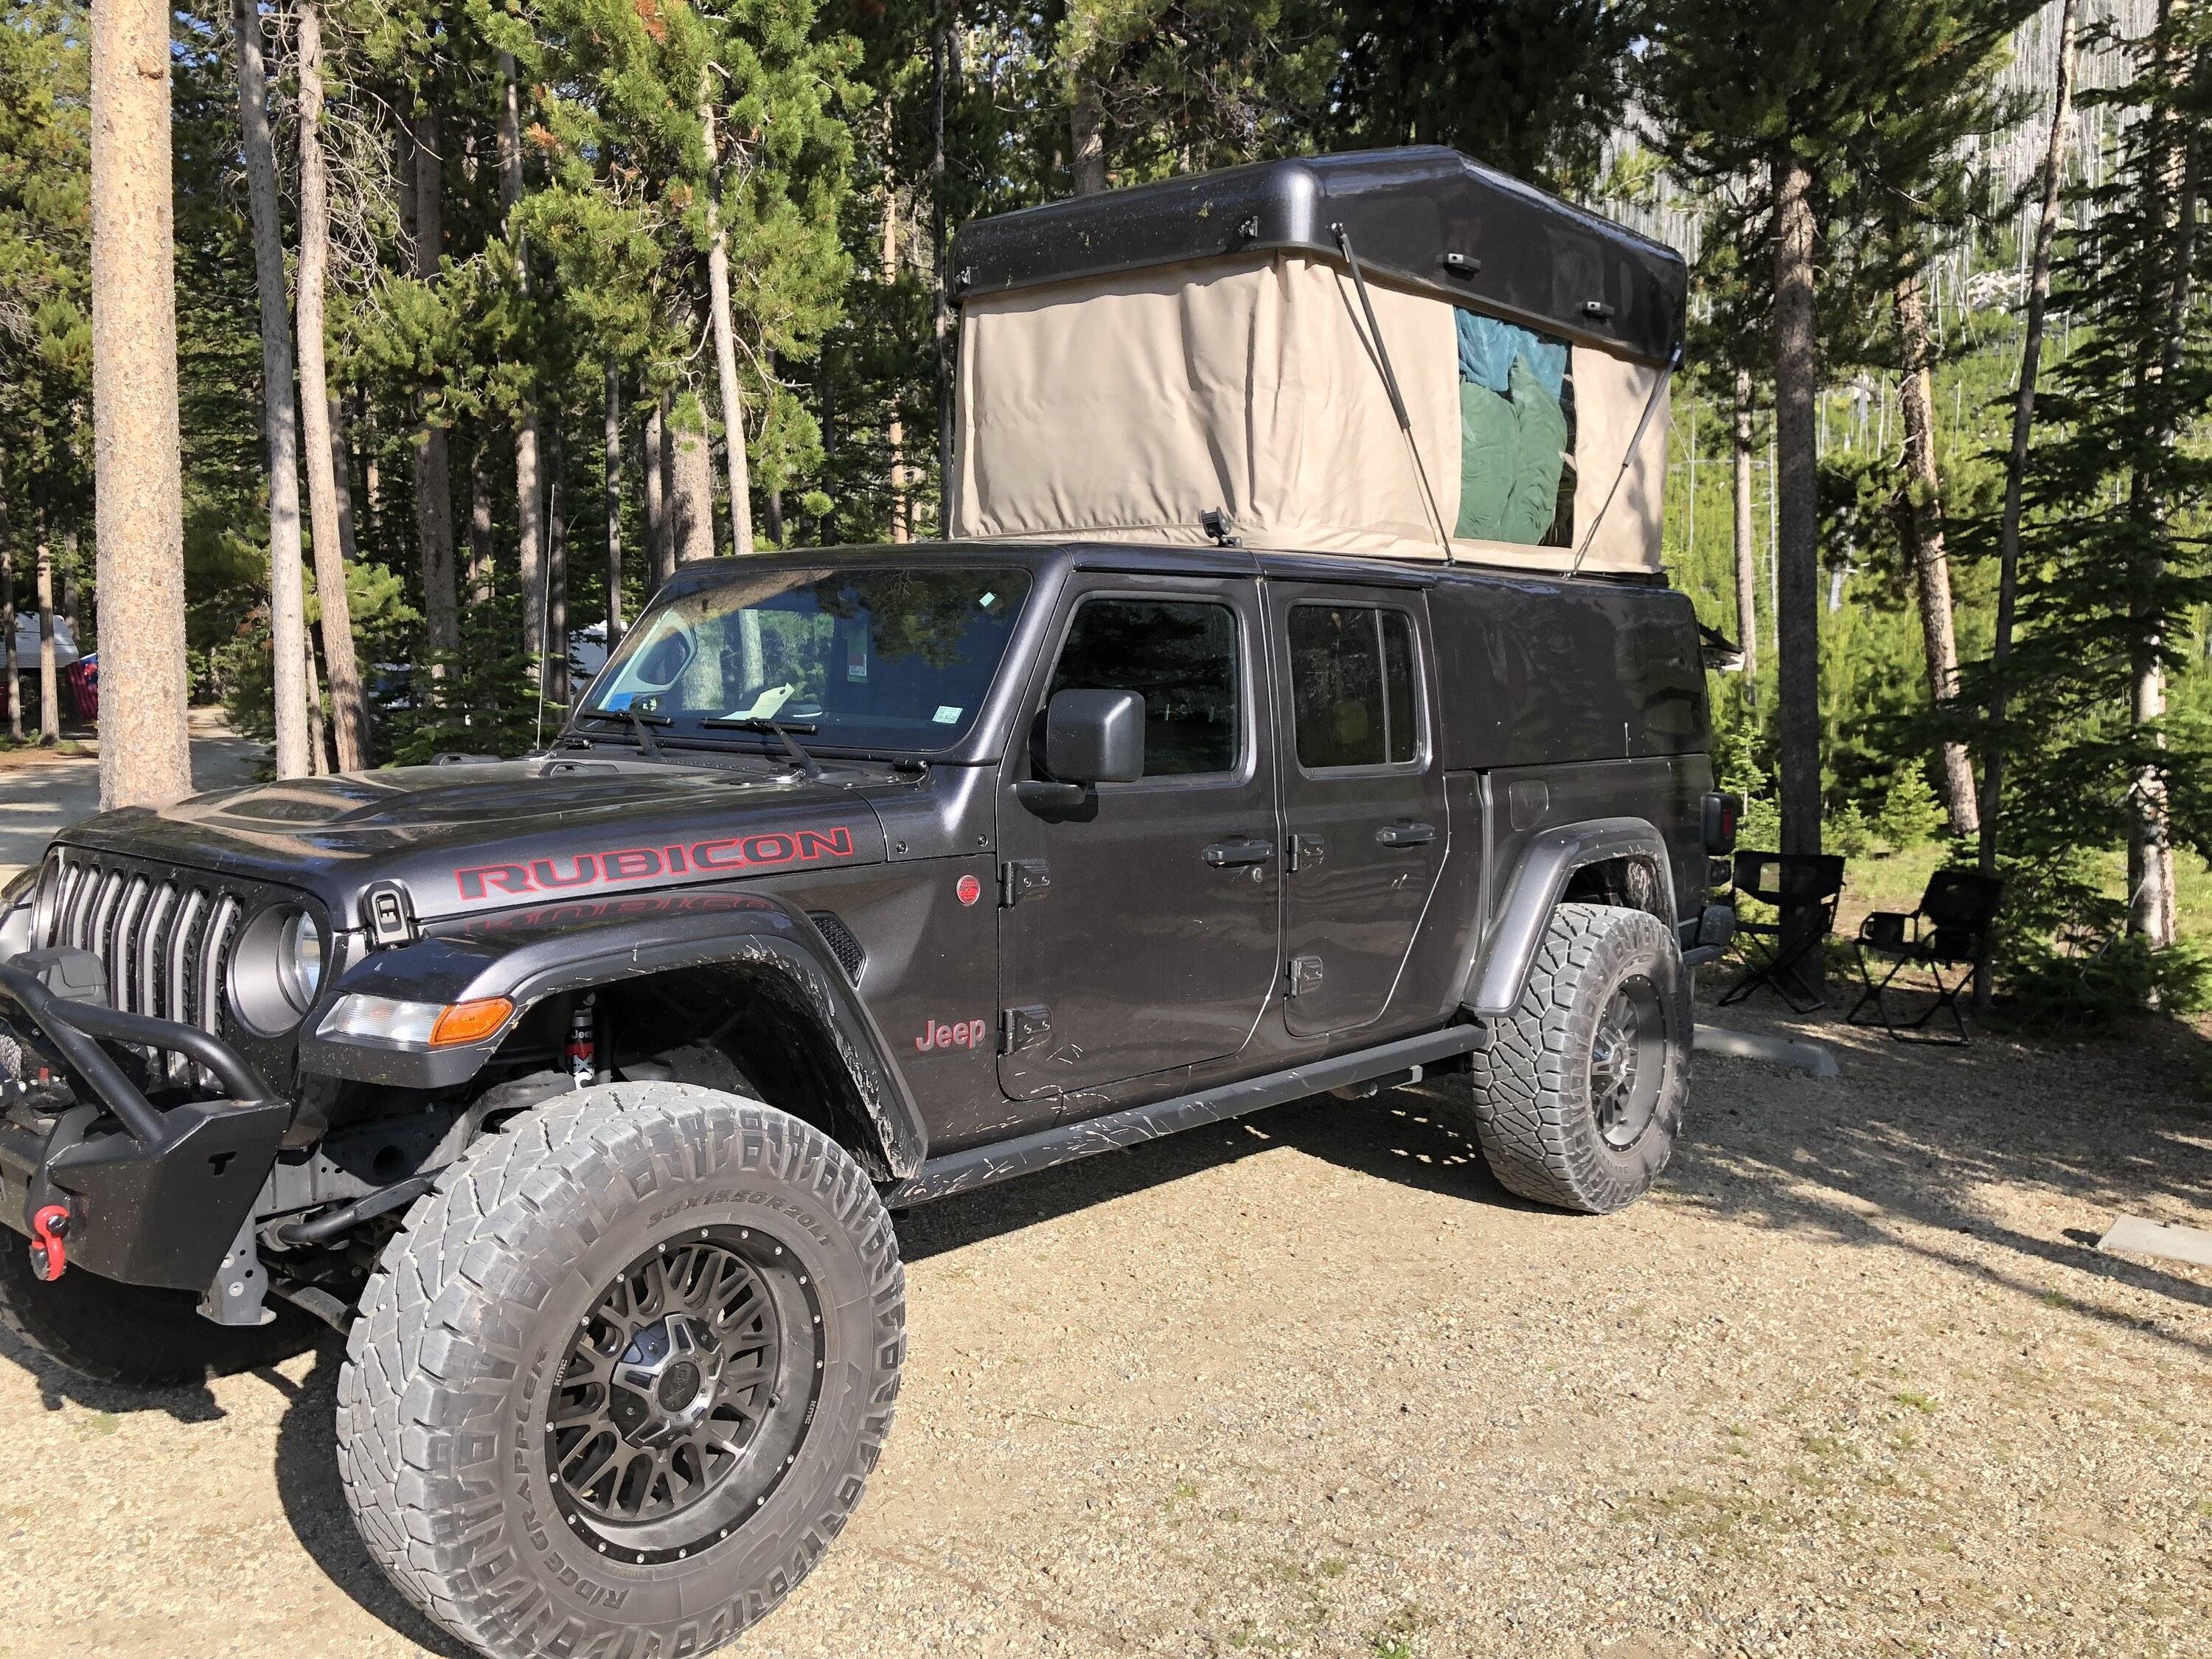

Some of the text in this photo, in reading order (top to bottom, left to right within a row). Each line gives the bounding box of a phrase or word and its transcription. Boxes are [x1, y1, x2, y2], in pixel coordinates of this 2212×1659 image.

[455, 827, 854, 900] RUBICON
[915, 1019, 987, 1052] Jeep
[514, 1343, 549, 1551] GRAPPLER
[543, 1551, 630, 1610] RIDGE
